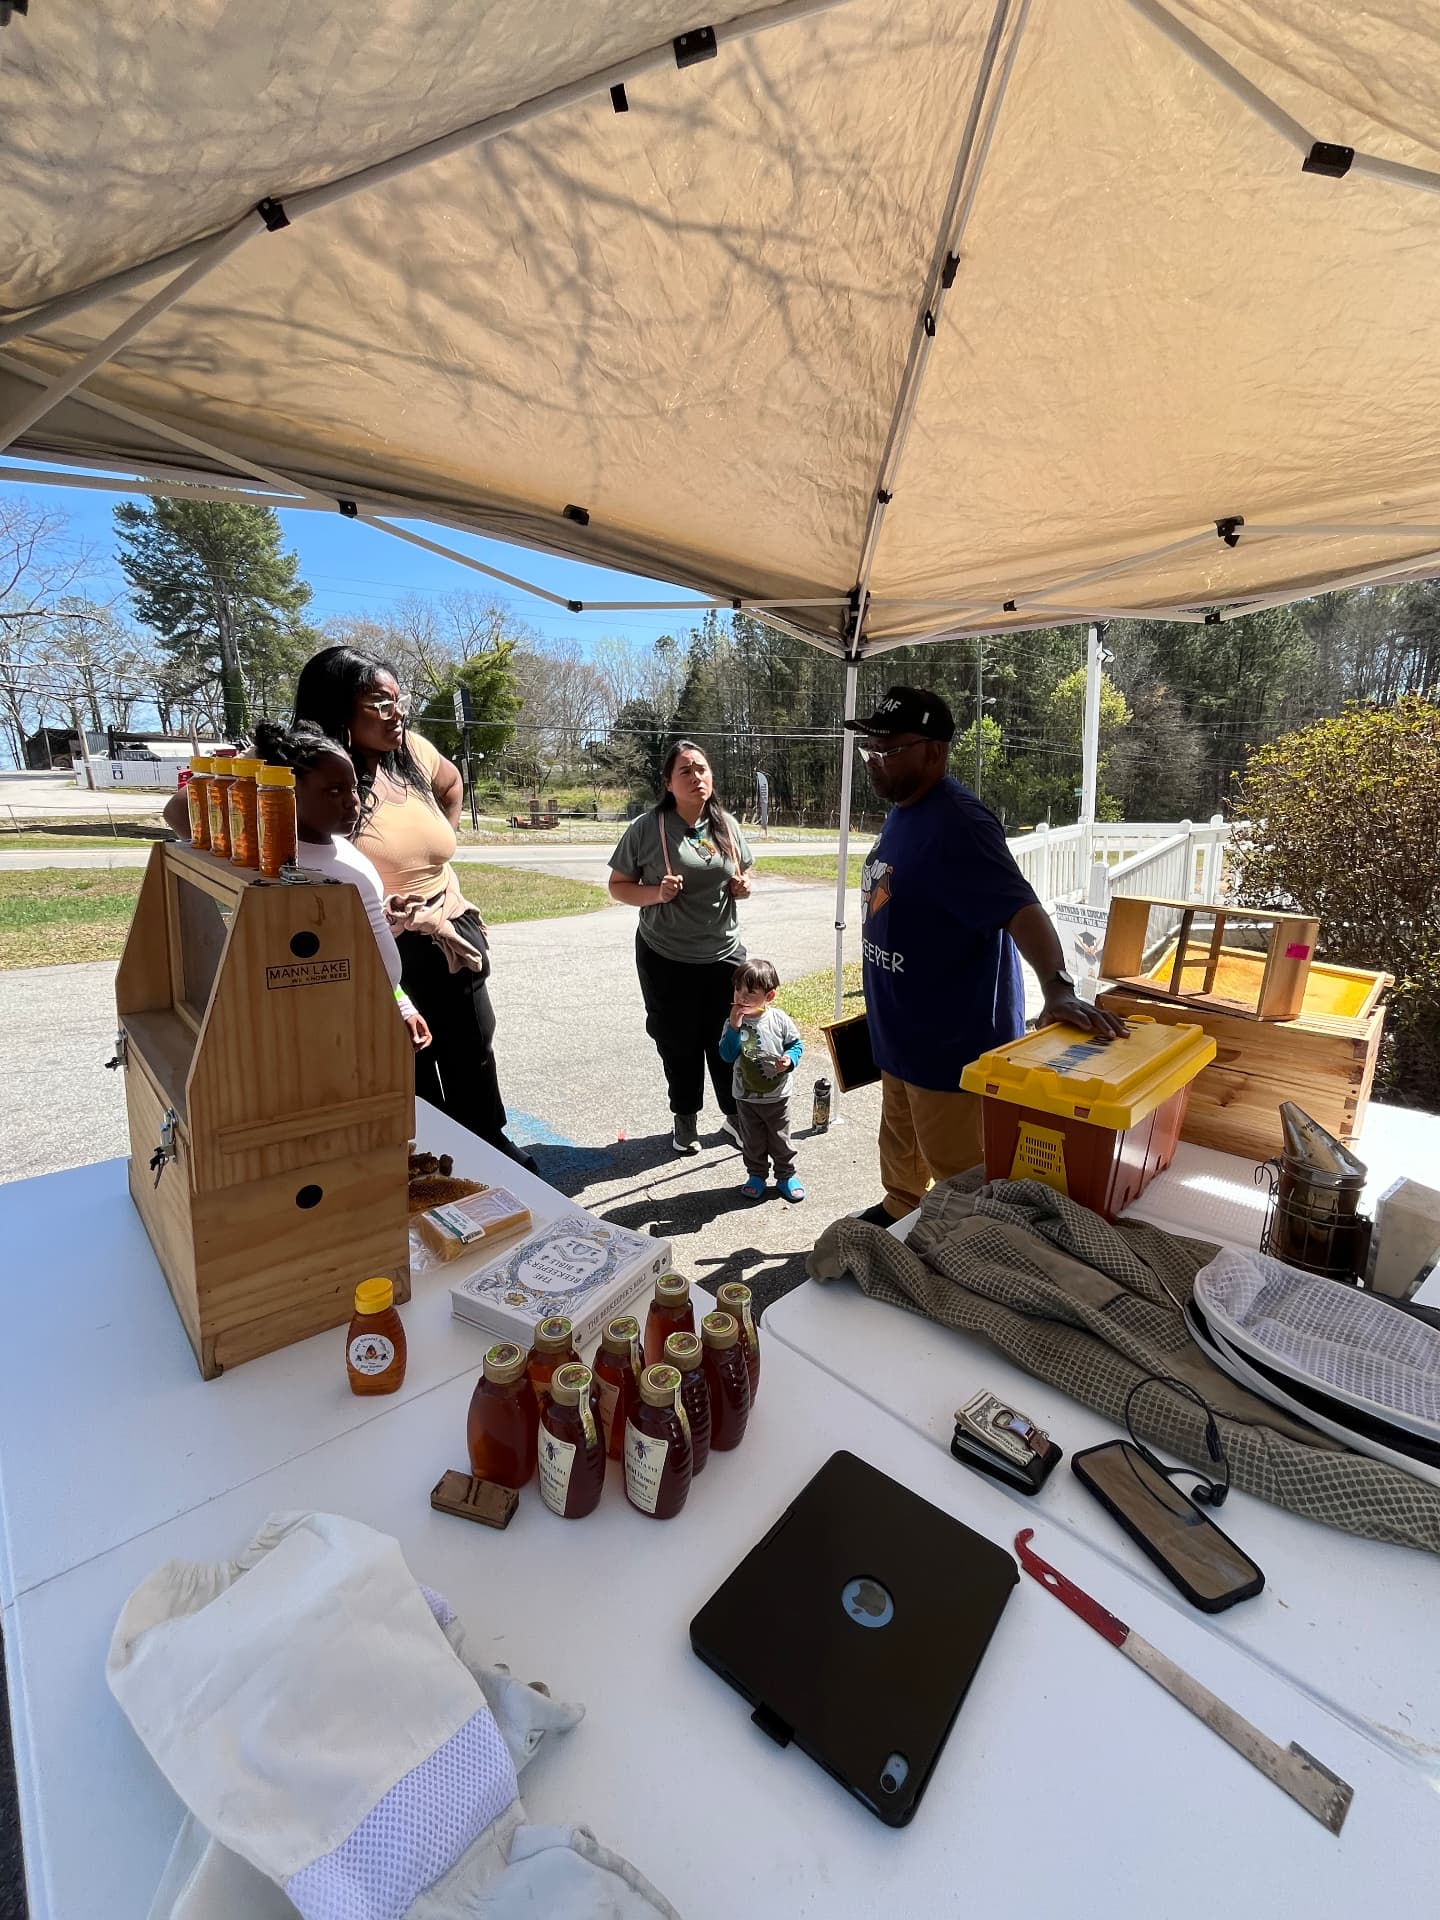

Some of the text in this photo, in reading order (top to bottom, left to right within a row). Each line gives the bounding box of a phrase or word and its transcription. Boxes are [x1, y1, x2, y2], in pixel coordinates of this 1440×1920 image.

[1056, 903, 1080, 916] PARTNERS
[269, 962, 347, 980] MANN LAKE
[306, 974, 328, 982] KNOW
[548, 1258, 575, 1271] BIBLE
[524, 1259, 582, 1284] BEEKEEPER'S
[532, 1272, 553, 1284] THE
